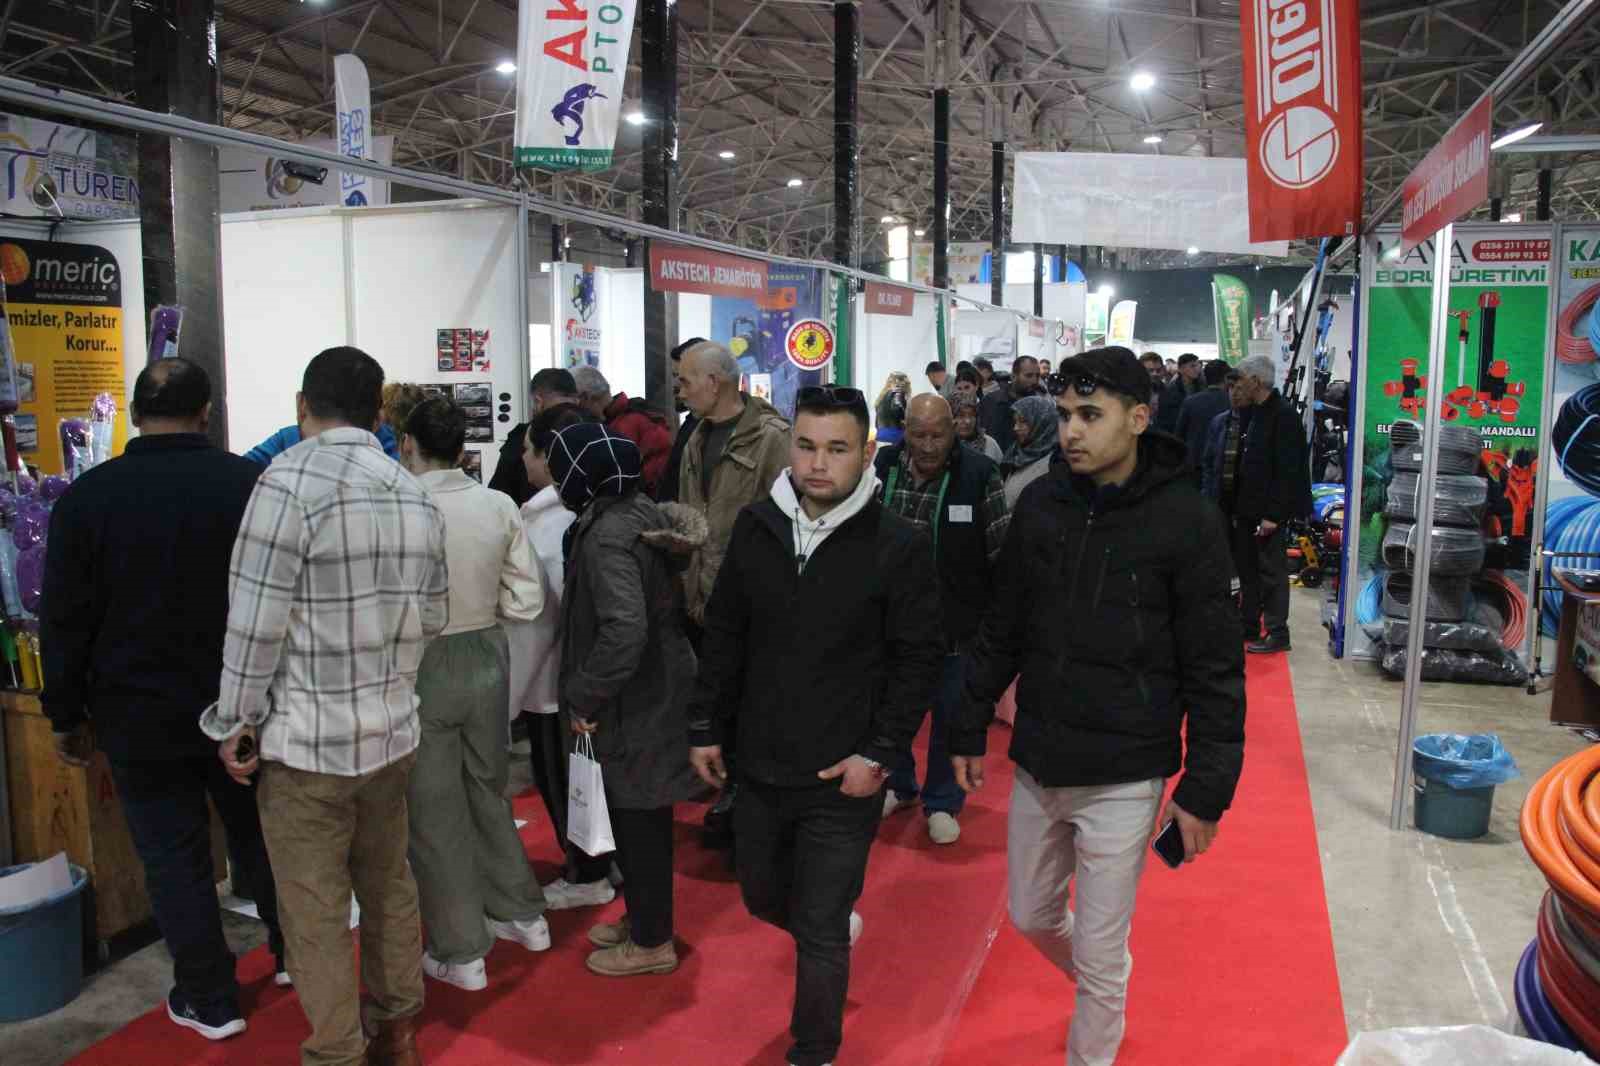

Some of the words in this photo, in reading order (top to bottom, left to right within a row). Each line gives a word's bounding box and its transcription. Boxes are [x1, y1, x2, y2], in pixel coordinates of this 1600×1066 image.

[592, 5, 623, 73] PTO
[34, 256, 116, 290] meriç
[661, 259, 710, 283] AKSTECH
[65, 310, 117, 329] Parlatır
[66, 335, 117, 352] Korur...
